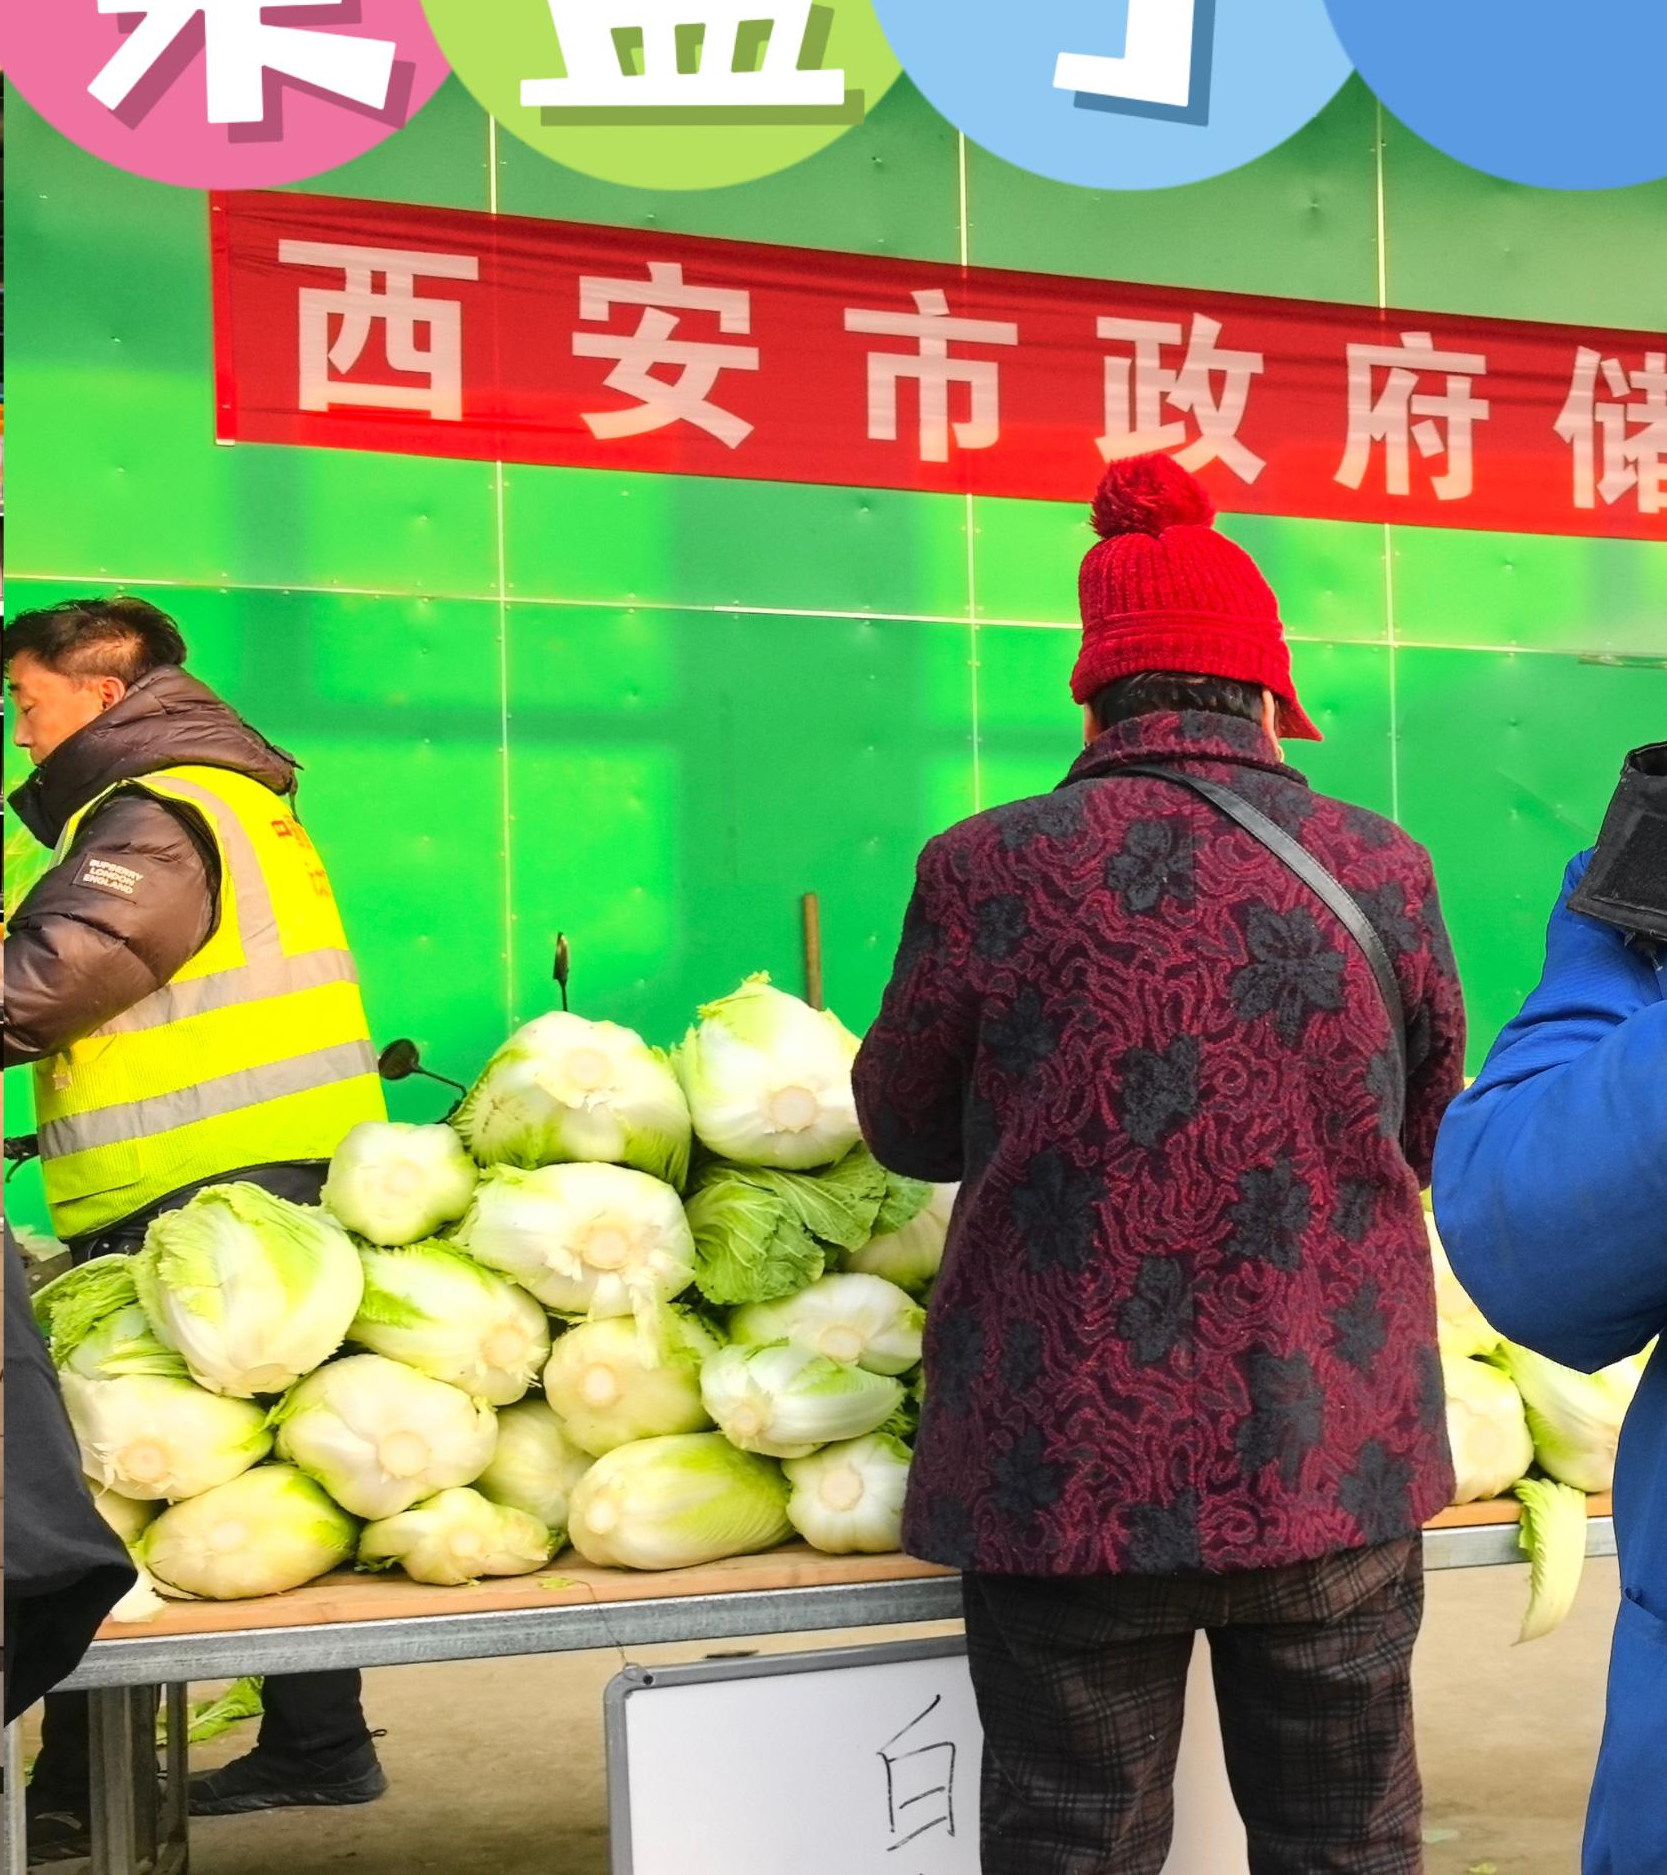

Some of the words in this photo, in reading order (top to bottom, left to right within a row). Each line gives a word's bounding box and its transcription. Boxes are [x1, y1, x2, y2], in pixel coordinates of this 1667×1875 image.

[83, 873, 133, 894] ENGLAND
[89, 867, 135, 887] LONDON
[876, 1694, 956, 1852] 白
